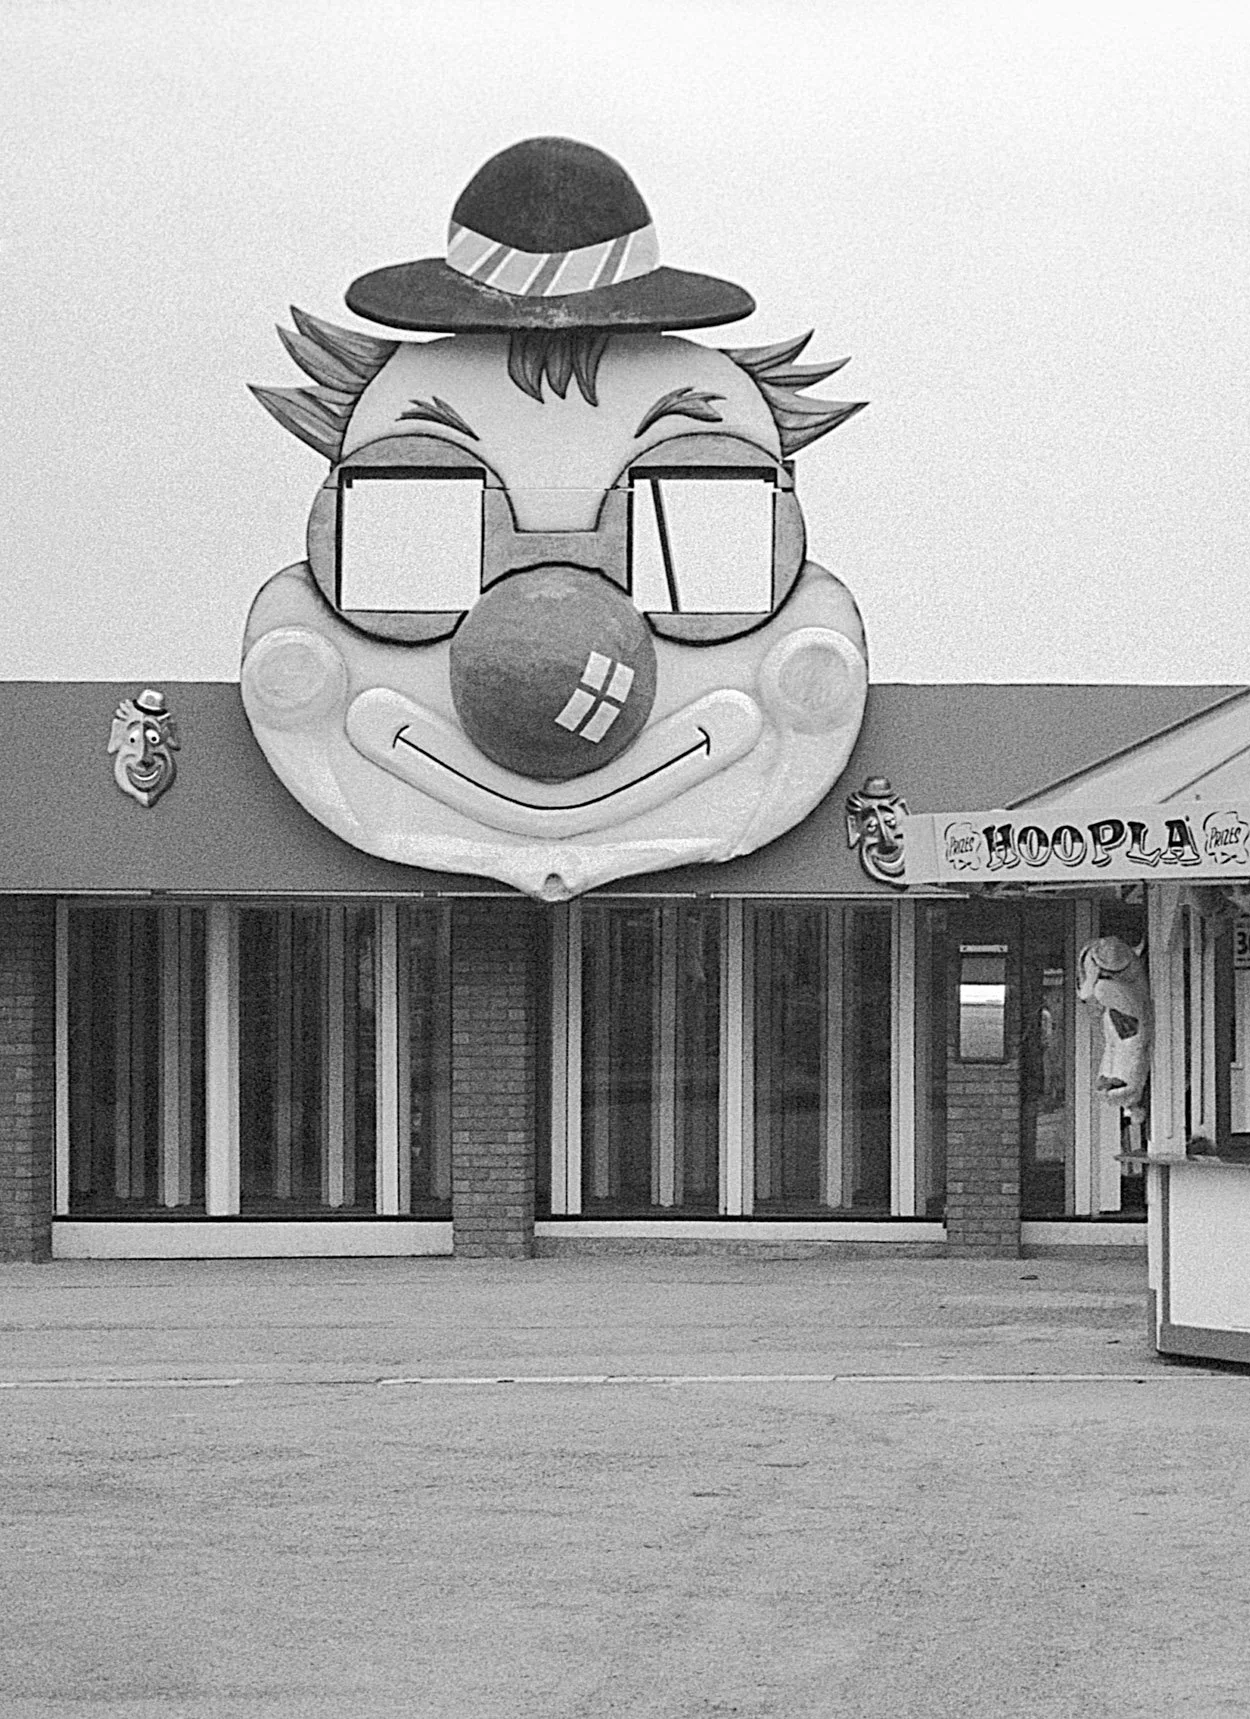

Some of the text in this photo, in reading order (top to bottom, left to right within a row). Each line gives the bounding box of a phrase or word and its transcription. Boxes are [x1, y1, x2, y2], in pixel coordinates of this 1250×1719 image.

[950, 818, 1242, 872] PRIZES HOOPLA PRIZES
